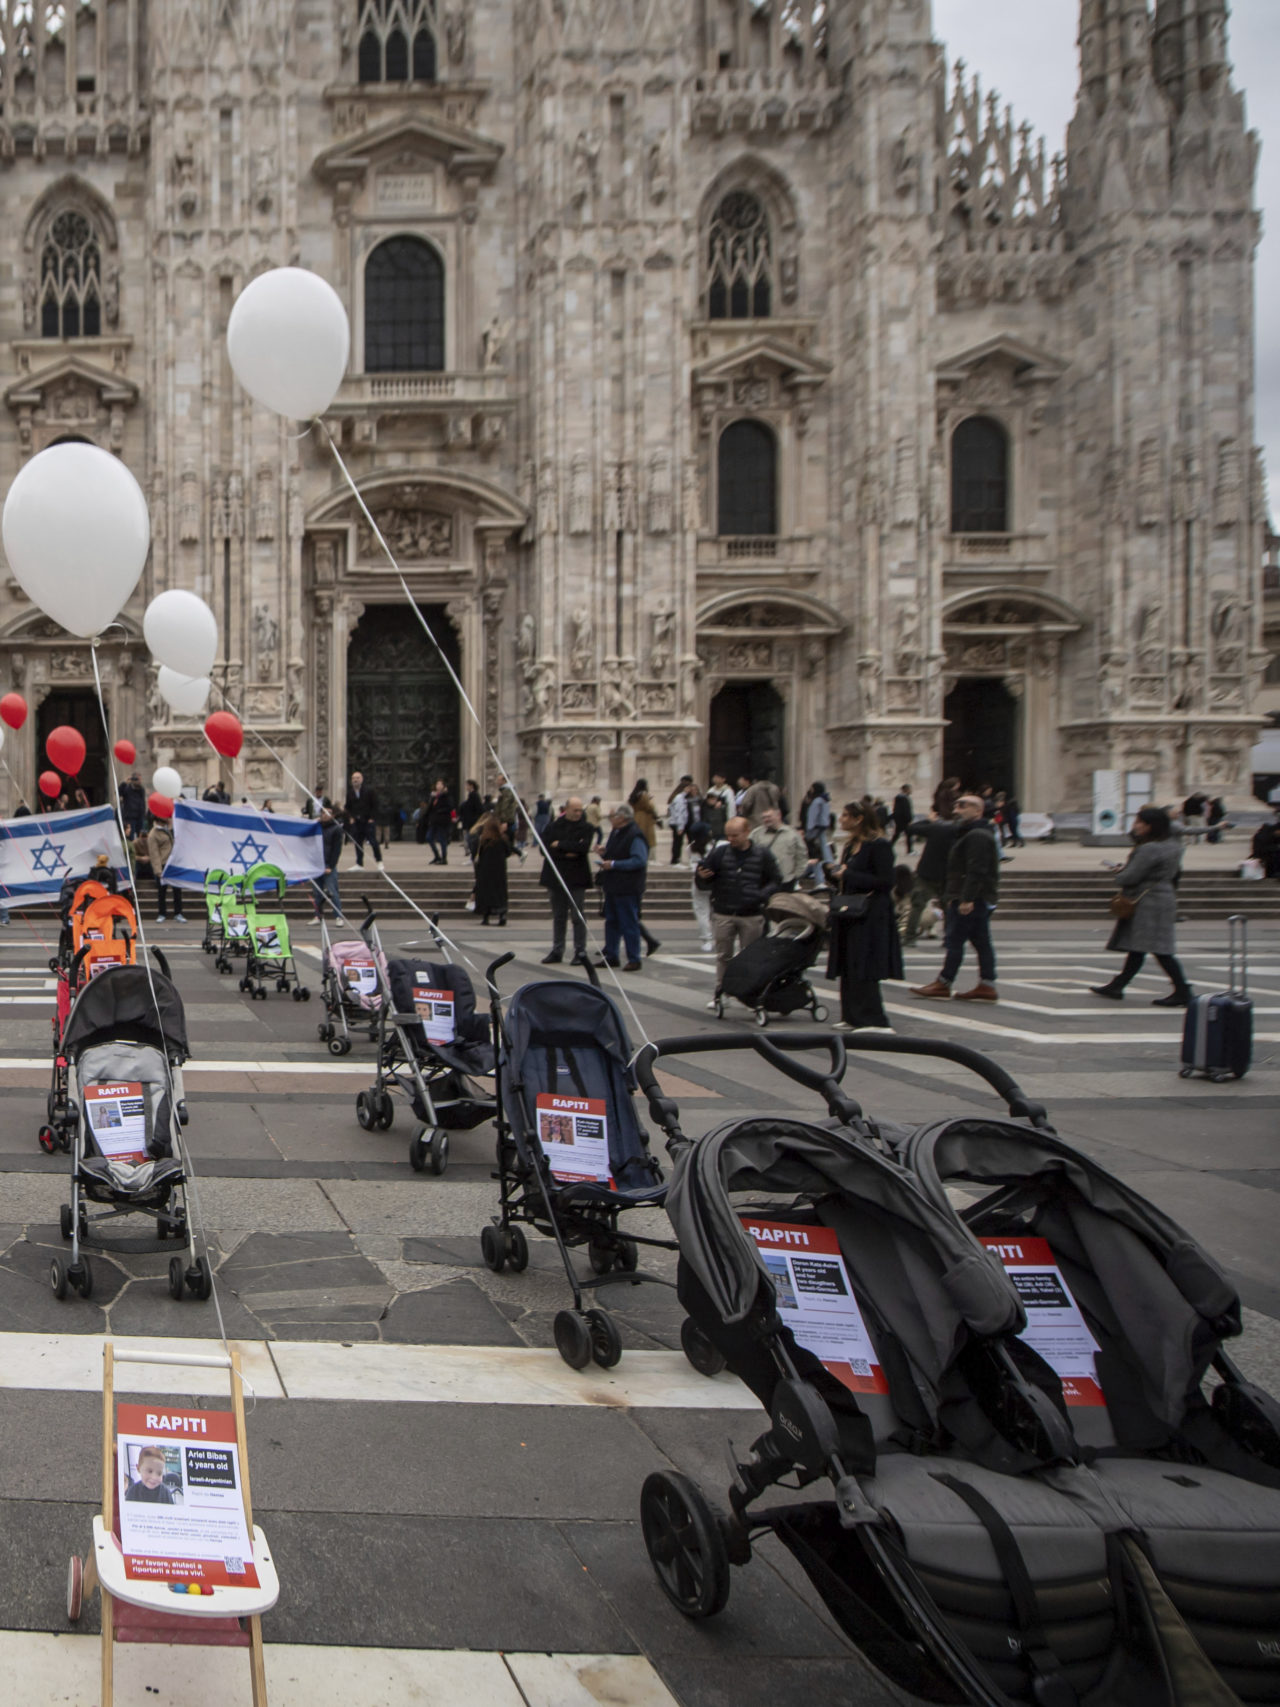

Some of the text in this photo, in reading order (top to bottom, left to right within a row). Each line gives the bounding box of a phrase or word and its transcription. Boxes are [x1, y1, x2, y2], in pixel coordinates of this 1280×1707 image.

[419, 991, 443, 999] RAPITI
[98, 1087, 130, 1096] RAPITI
[552, 1098, 589, 1110] RAPITI
[749, 1226, 809, 1245] RAPITI
[146, 1413, 207, 1433] RAPITI
[188, 1450, 205, 1459] Ariel
[207, 1451, 227, 1460] Bibas
[188, 1460, 228, 1470] 4 years old
[131, 1558, 144, 1566] Per
[145, 1559, 171, 1568] favore,
[172, 1561, 196, 1569] aiutaci
[132, 1566, 164, 1574] riportarli
